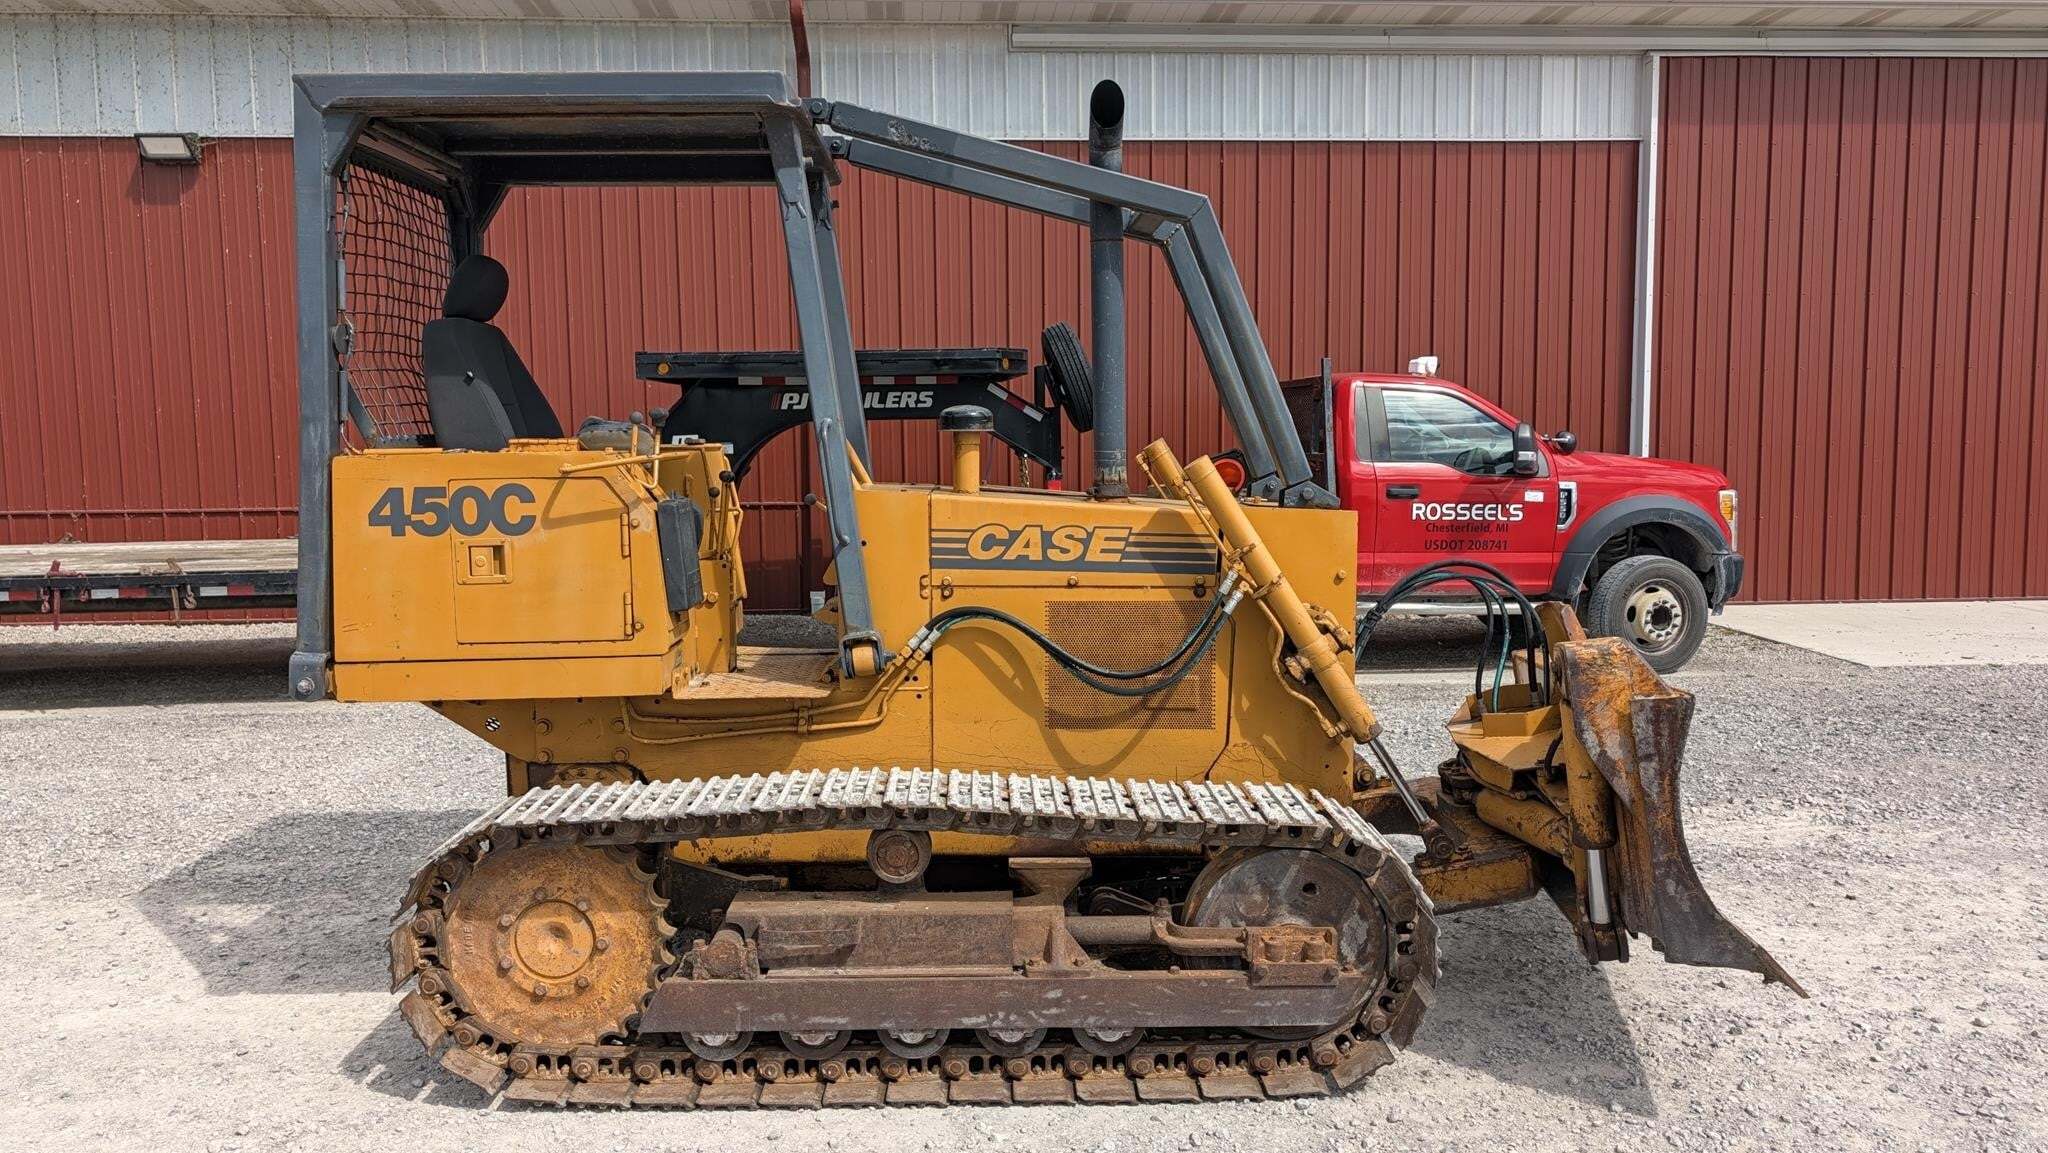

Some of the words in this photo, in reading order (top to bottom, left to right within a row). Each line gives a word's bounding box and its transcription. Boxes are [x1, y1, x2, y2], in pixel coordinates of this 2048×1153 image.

[780, 392, 810, 410] PJ
[367, 483, 537, 537] 450C
[1411, 502, 1524, 521] ROSSEEL'S
[1425, 522, 1492, 533] Chesterfield,
[1495, 523, 1509, 533] MI
[967, 523, 1132, 563] CASE
[1424, 540, 1463, 551] USDOT
[1466, 540, 1508, 551] 208741
